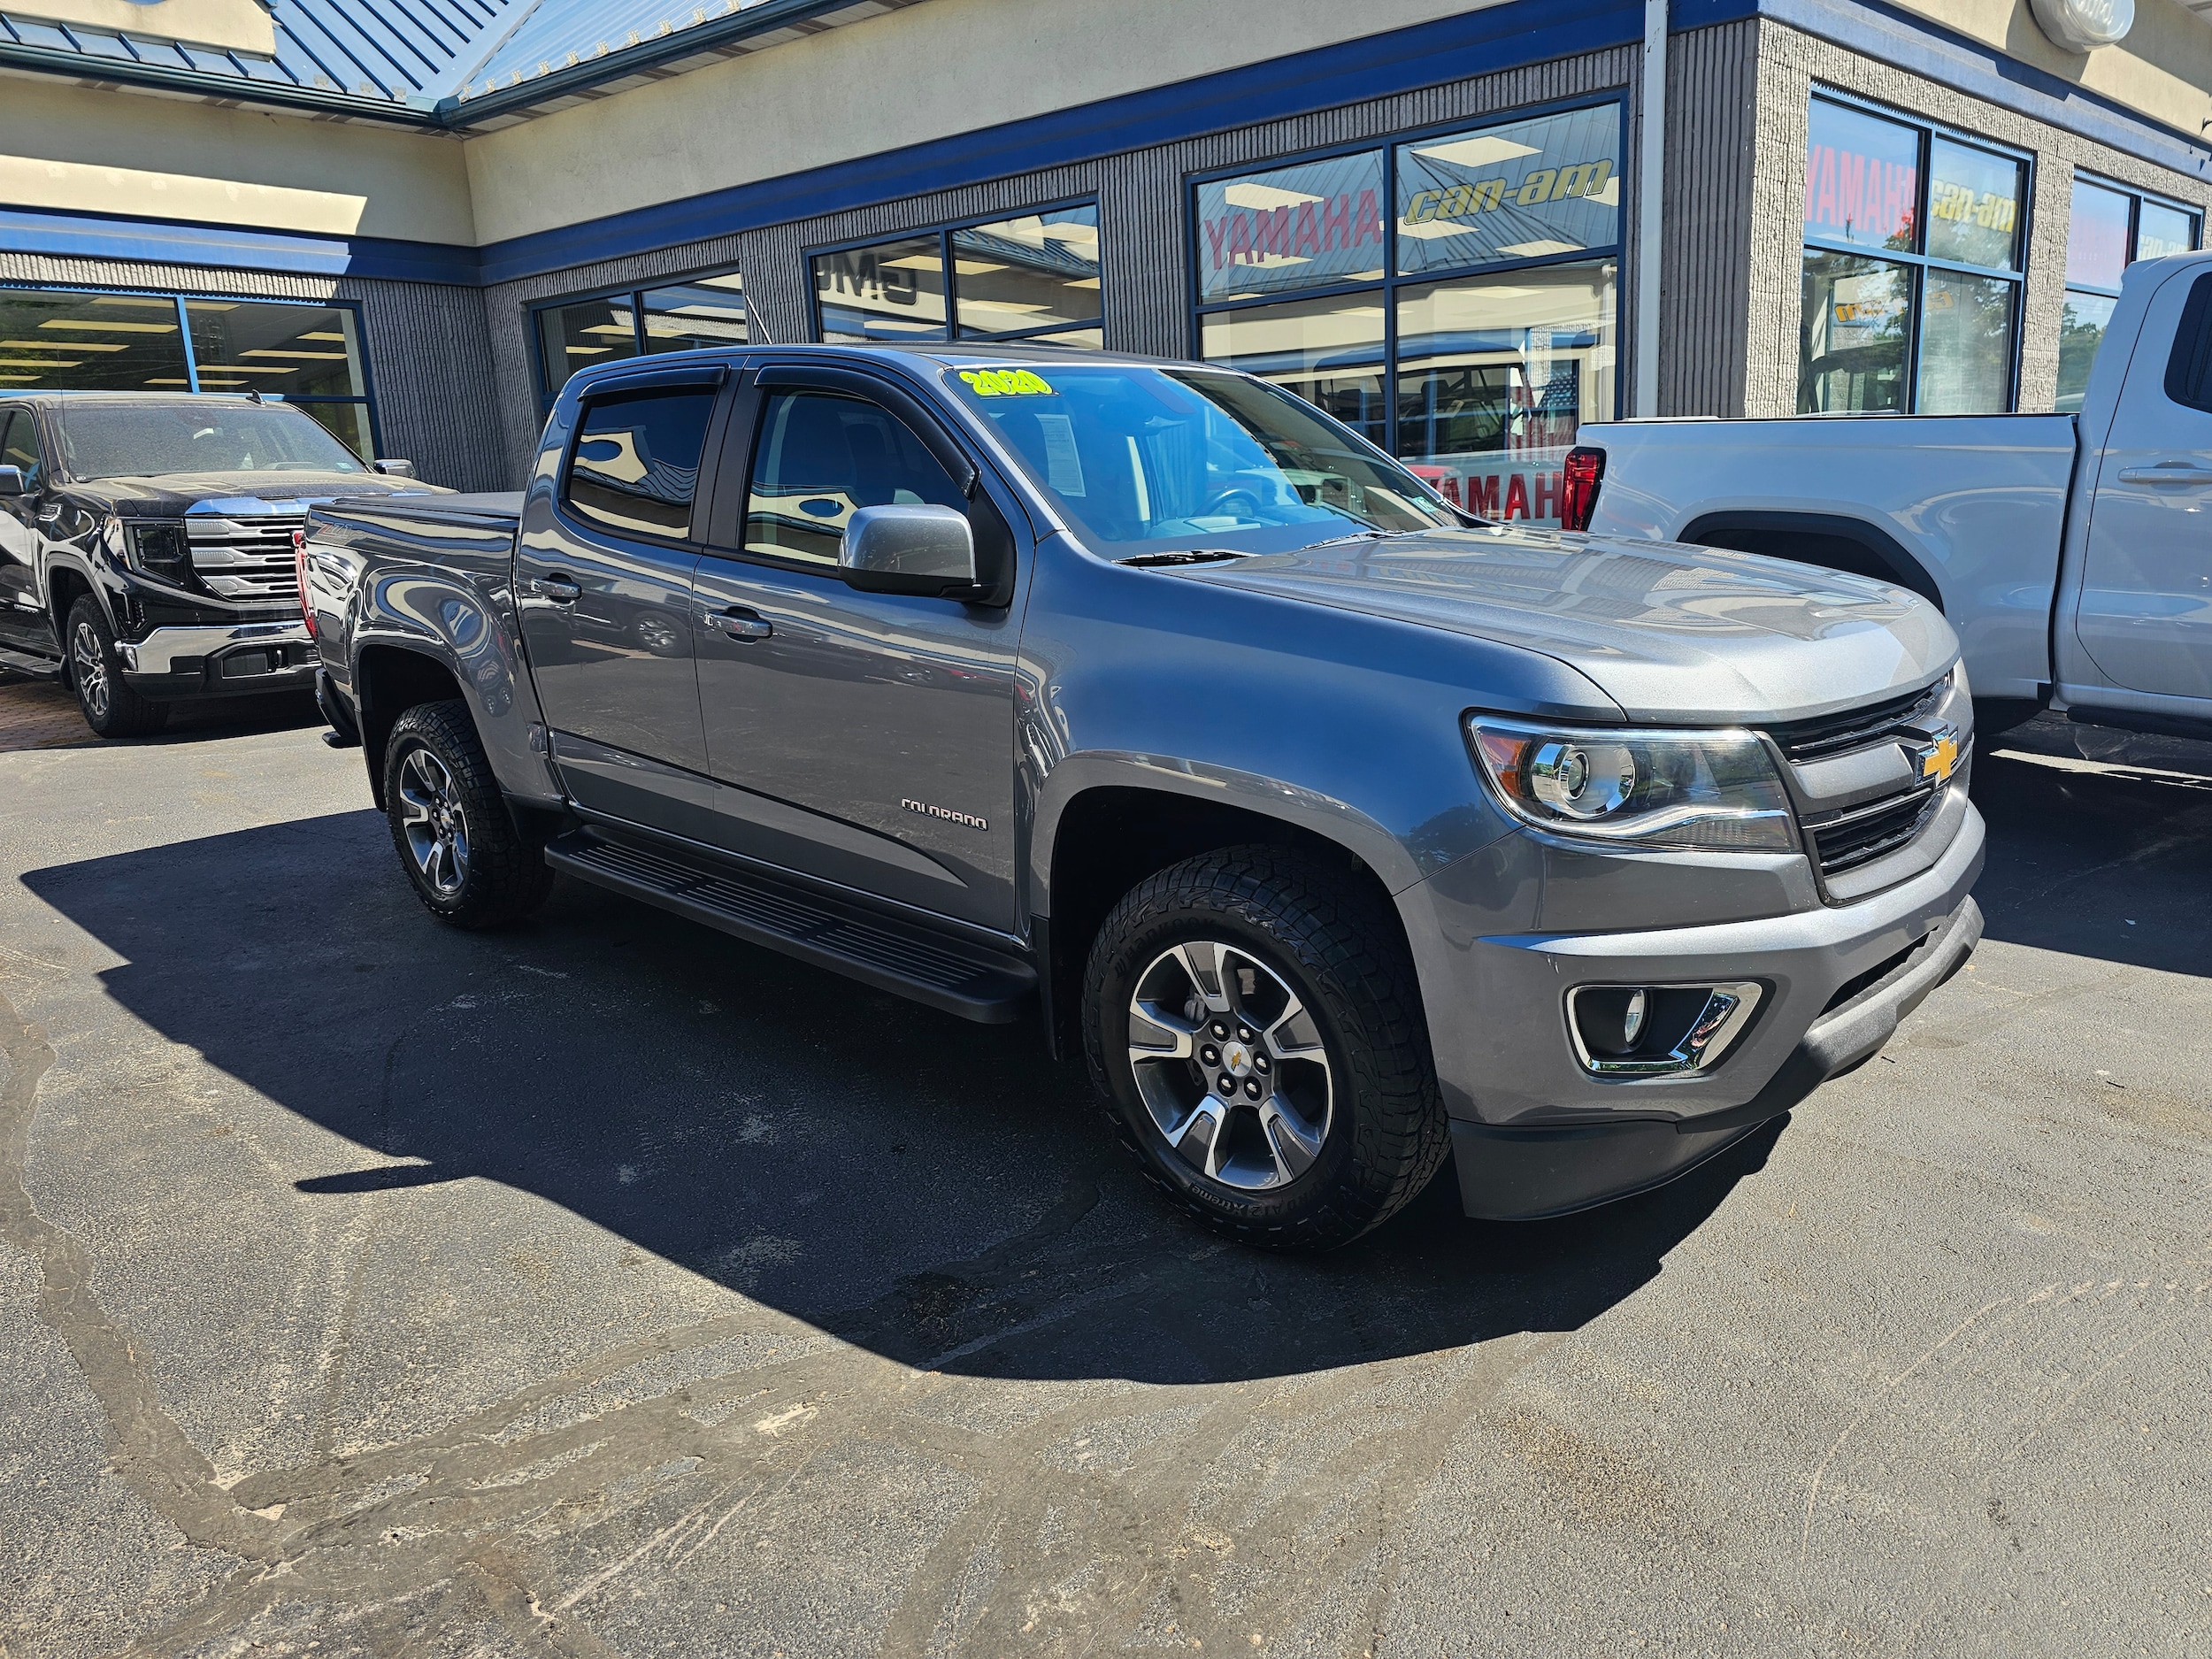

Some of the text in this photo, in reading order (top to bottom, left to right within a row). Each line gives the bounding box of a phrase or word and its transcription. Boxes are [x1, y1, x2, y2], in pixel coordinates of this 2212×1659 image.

[1402, 157, 1614, 227] can-am
[1204, 188, 1382, 271] YAMAHA
[958, 369, 1054, 396] 2020
[901, 798, 988, 831] COLORADO
